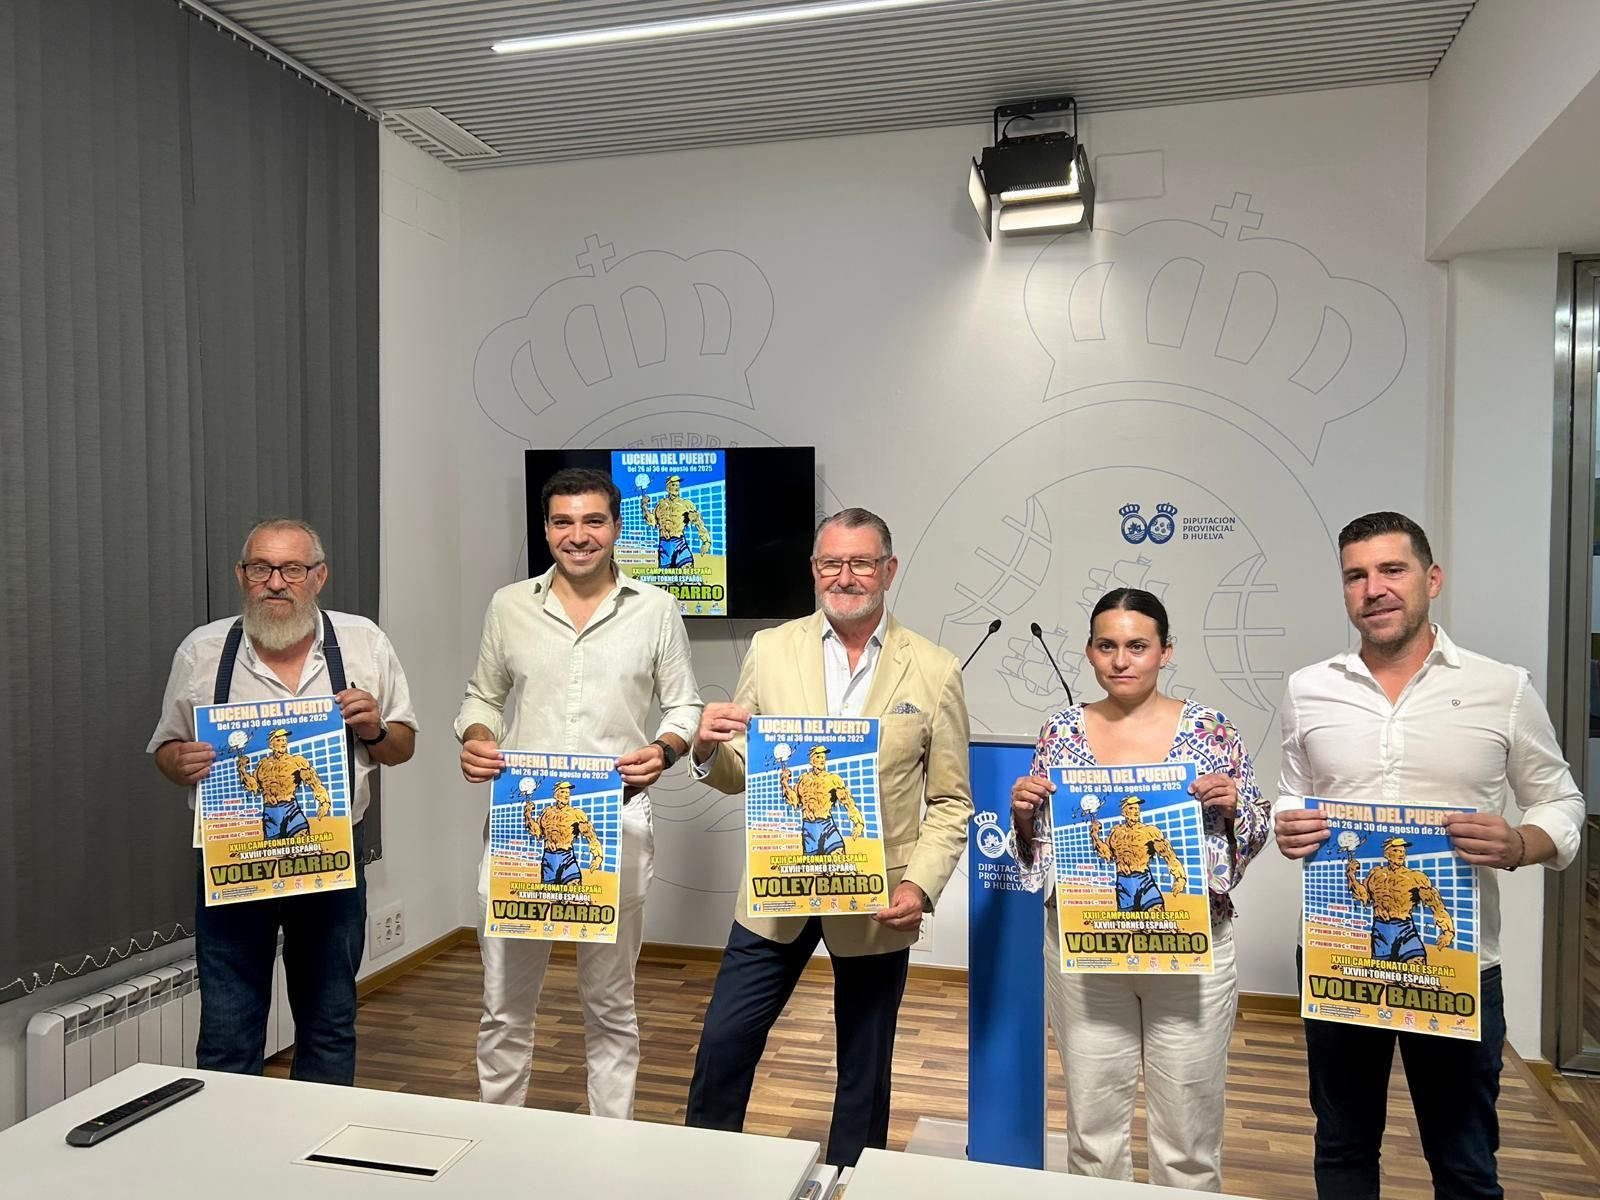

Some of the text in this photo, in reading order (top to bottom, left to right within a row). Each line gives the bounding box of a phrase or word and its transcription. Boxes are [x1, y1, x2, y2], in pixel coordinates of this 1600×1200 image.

[622, 453, 717, 465] LUCENA DEL PUERTO
[692, 567, 712, 575] ESPAÑA
[209, 699, 333, 723] LUCENA DEL PUERTO
[217, 714, 327, 731] Del 26 al 30 de agosto de 2025
[758, 719, 870, 734] LUCENA DEL PUERTO
[765, 734, 776, 742] Del
[777, 734, 785, 742] 26
[786, 734, 793, 742] al
[795, 734, 802, 742] 30
[804, 734, 812, 742] de
[814, 734, 836, 743] agosto
[838, 734, 846, 742] de
[505, 754, 615, 772] LUCENA DEL PUERTO
[523, 768, 531, 776] 26
[532, 768, 538, 776] al
[550, 769, 558, 777] de
[559, 770, 581, 779] agosto
[1062, 766, 1186, 784] LUCENA DEL PUERTO
[1070, 782, 1181, 793] Del 26 al 30 de agosto de 2025
[1375, 807, 1402, 824] DEL
[1327, 819, 1340, 829] Del
[1342, 821, 1352, 829] 26
[1354, 822, 1362, 830] al
[1364, 823, 1374, 832] 30
[1377, 823, 1387, 833] de
[1390, 825, 1419, 836] agosto
[1422, 826, 1432, 835] de
[229, 832, 333, 852] XXIII CAMPEONATO DE ESPAÑA
[240, 843, 321, 860] XXVIII TORNEO ESPAÑOL
[770, 854, 868, 864] XXIII CAMPEONATO DE ESPAÑA
[211, 851, 350, 885] VOLEY BARRO
[780, 863, 857, 874] XXVIII TORNEO ESPAÑOL
[510, 882, 602, 894] XXIII CAMPEONATO DE ESPAÑA
[753, 874, 884, 897] VOLEY BARRO
[518, 891, 591, 901] XXVIII TORNEO ESPAÑOL
[493, 900, 615, 924] VOLEY BARRO
[1083, 910, 1189, 920] XXIII CAMPEONATO DE ESPAÑA
[1094, 920, 1177, 930] XXVIII TORNEO ESPAÑOL
[1065, 932, 1208, 954] VOLEY BARRO
[1331, 954, 1455, 977] XXIII CAMPEONATO DE ESPAÑA
[1343, 966, 1440, 986] XXVIII TORNEO ESPAÑOL
[1309, 975, 1385, 1005] VOLEY
[1386, 985, 1475, 1017] BARRO
